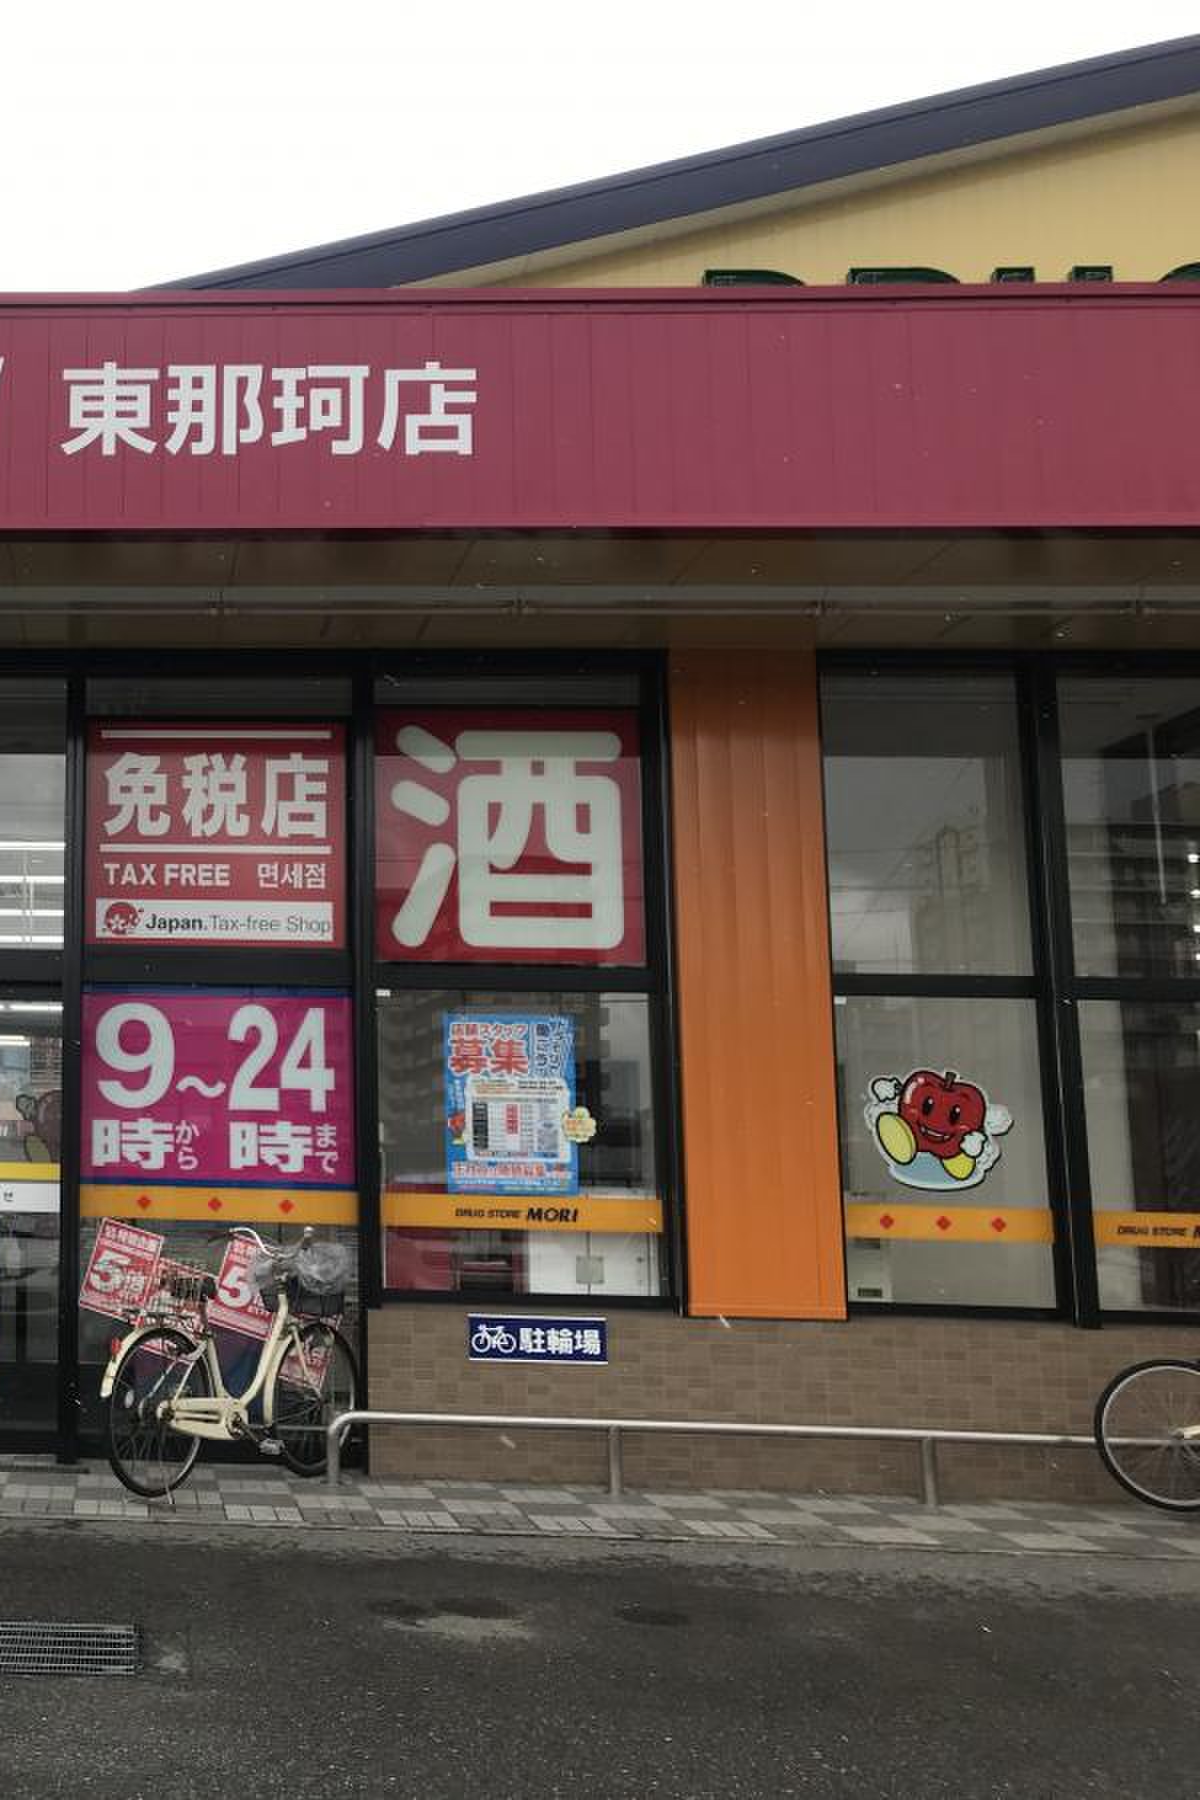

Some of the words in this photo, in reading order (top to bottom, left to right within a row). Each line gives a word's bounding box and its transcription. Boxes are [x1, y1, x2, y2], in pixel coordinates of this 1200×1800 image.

[61, 361, 478, 456] 東那珂店
[103, 751, 329, 838] 免税店
[391, 725, 625, 949] 酒
[104, 862, 157, 887] TAX
[164, 863, 231, 887] FREE
[257, 863, 326, 889] 면세점
[286, 914, 331, 935] Shop
[450, 1038, 530, 1074] 募集
[526, 1207, 579, 1223] MORI
[518, 1327, 601, 1355] 駐輪場
